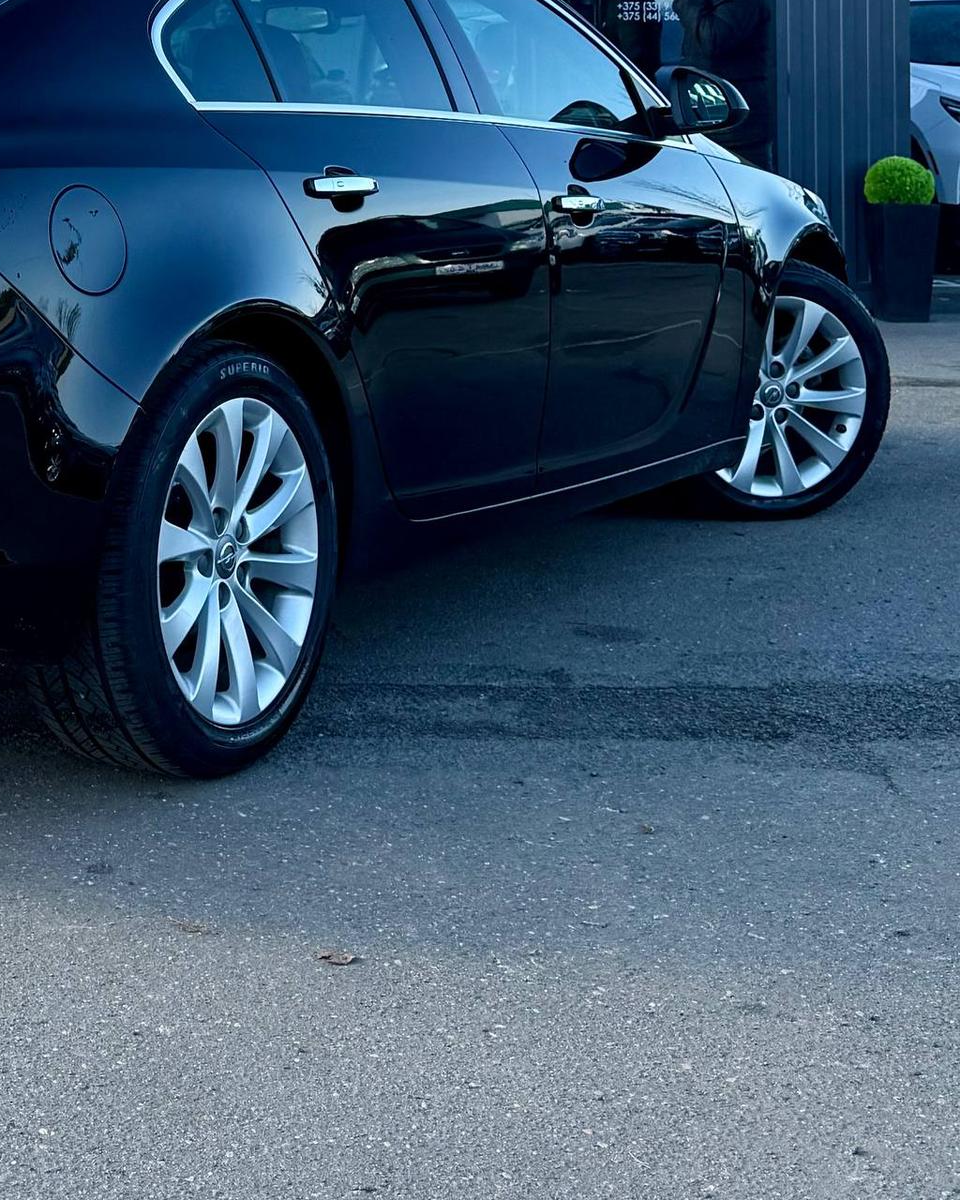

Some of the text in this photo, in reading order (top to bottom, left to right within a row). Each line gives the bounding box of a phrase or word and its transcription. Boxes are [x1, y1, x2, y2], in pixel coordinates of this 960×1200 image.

[616, 2, 640, 11] +375
[616, 12, 640, 21] +375
[643, 12, 661, 23] (44)
